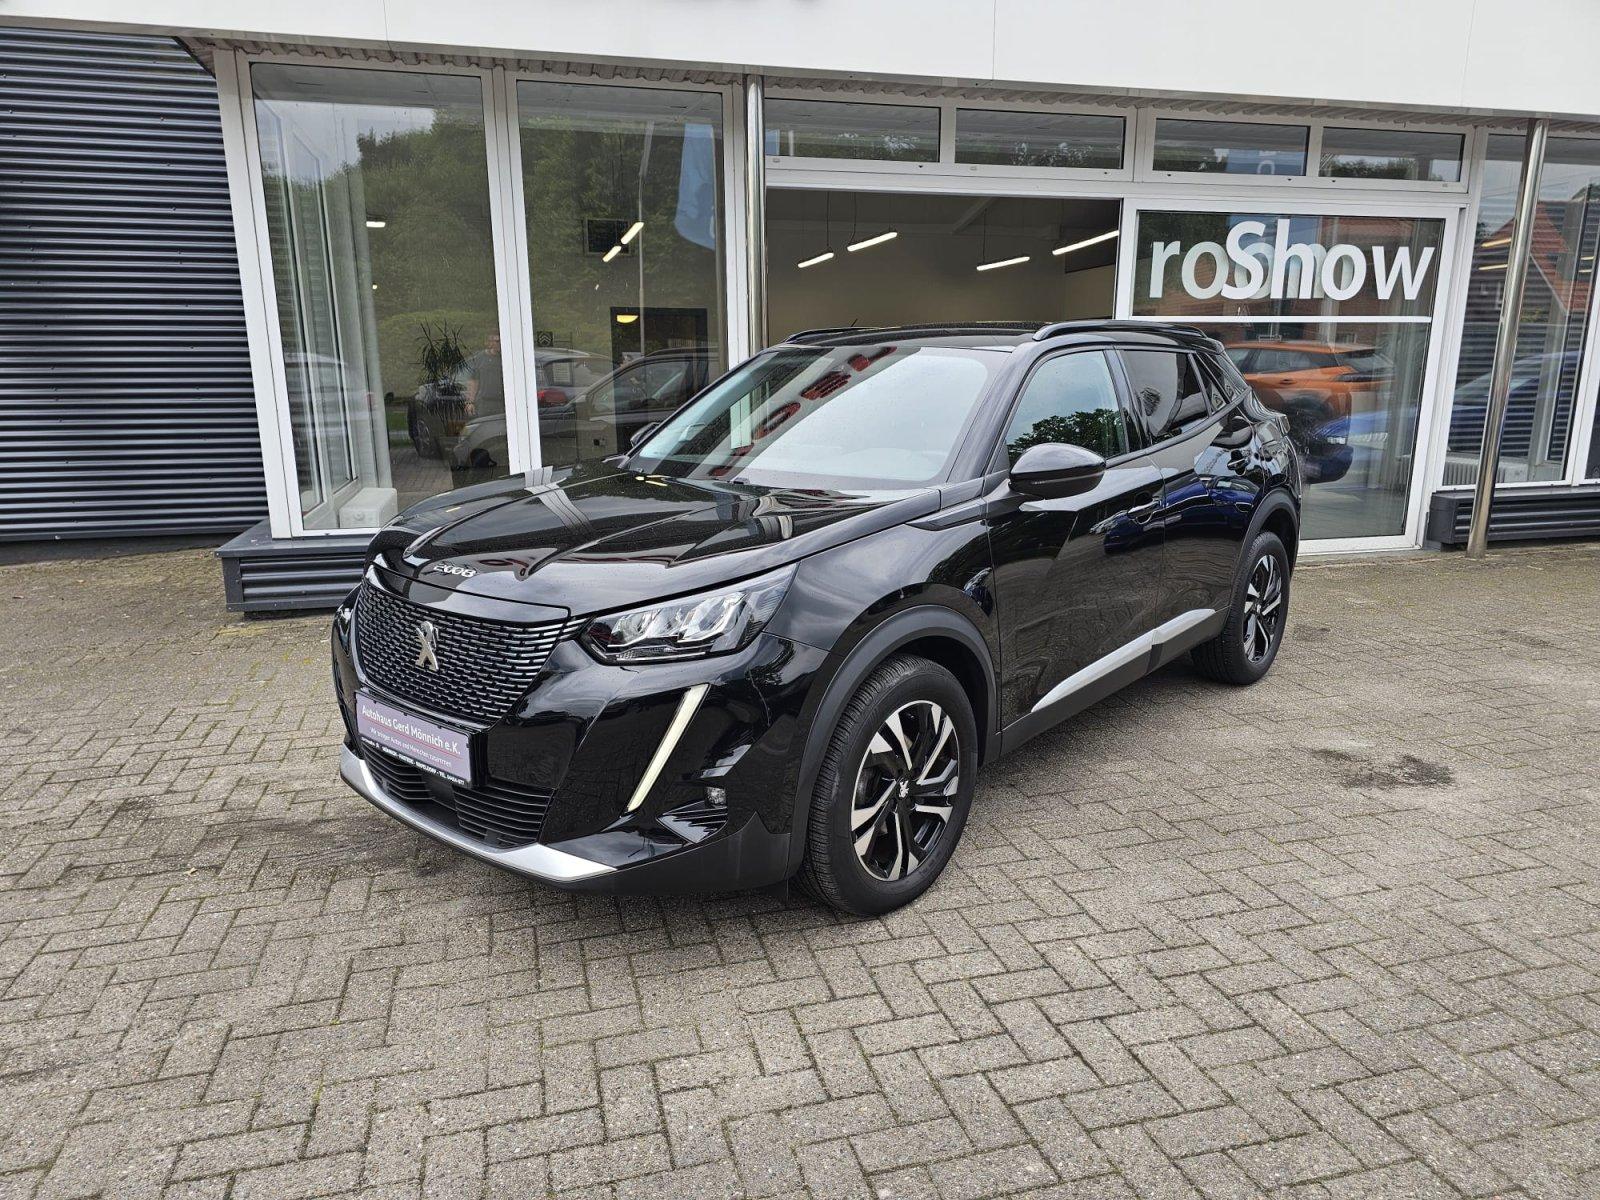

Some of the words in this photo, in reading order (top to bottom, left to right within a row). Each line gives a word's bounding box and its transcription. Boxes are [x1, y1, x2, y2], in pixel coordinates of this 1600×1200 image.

[433, 563, 477, 578] 2008
[362, 704, 392, 727] Autohaus
[393, 718, 410, 734] Gerd
[411, 725, 443, 748] Mönnich
